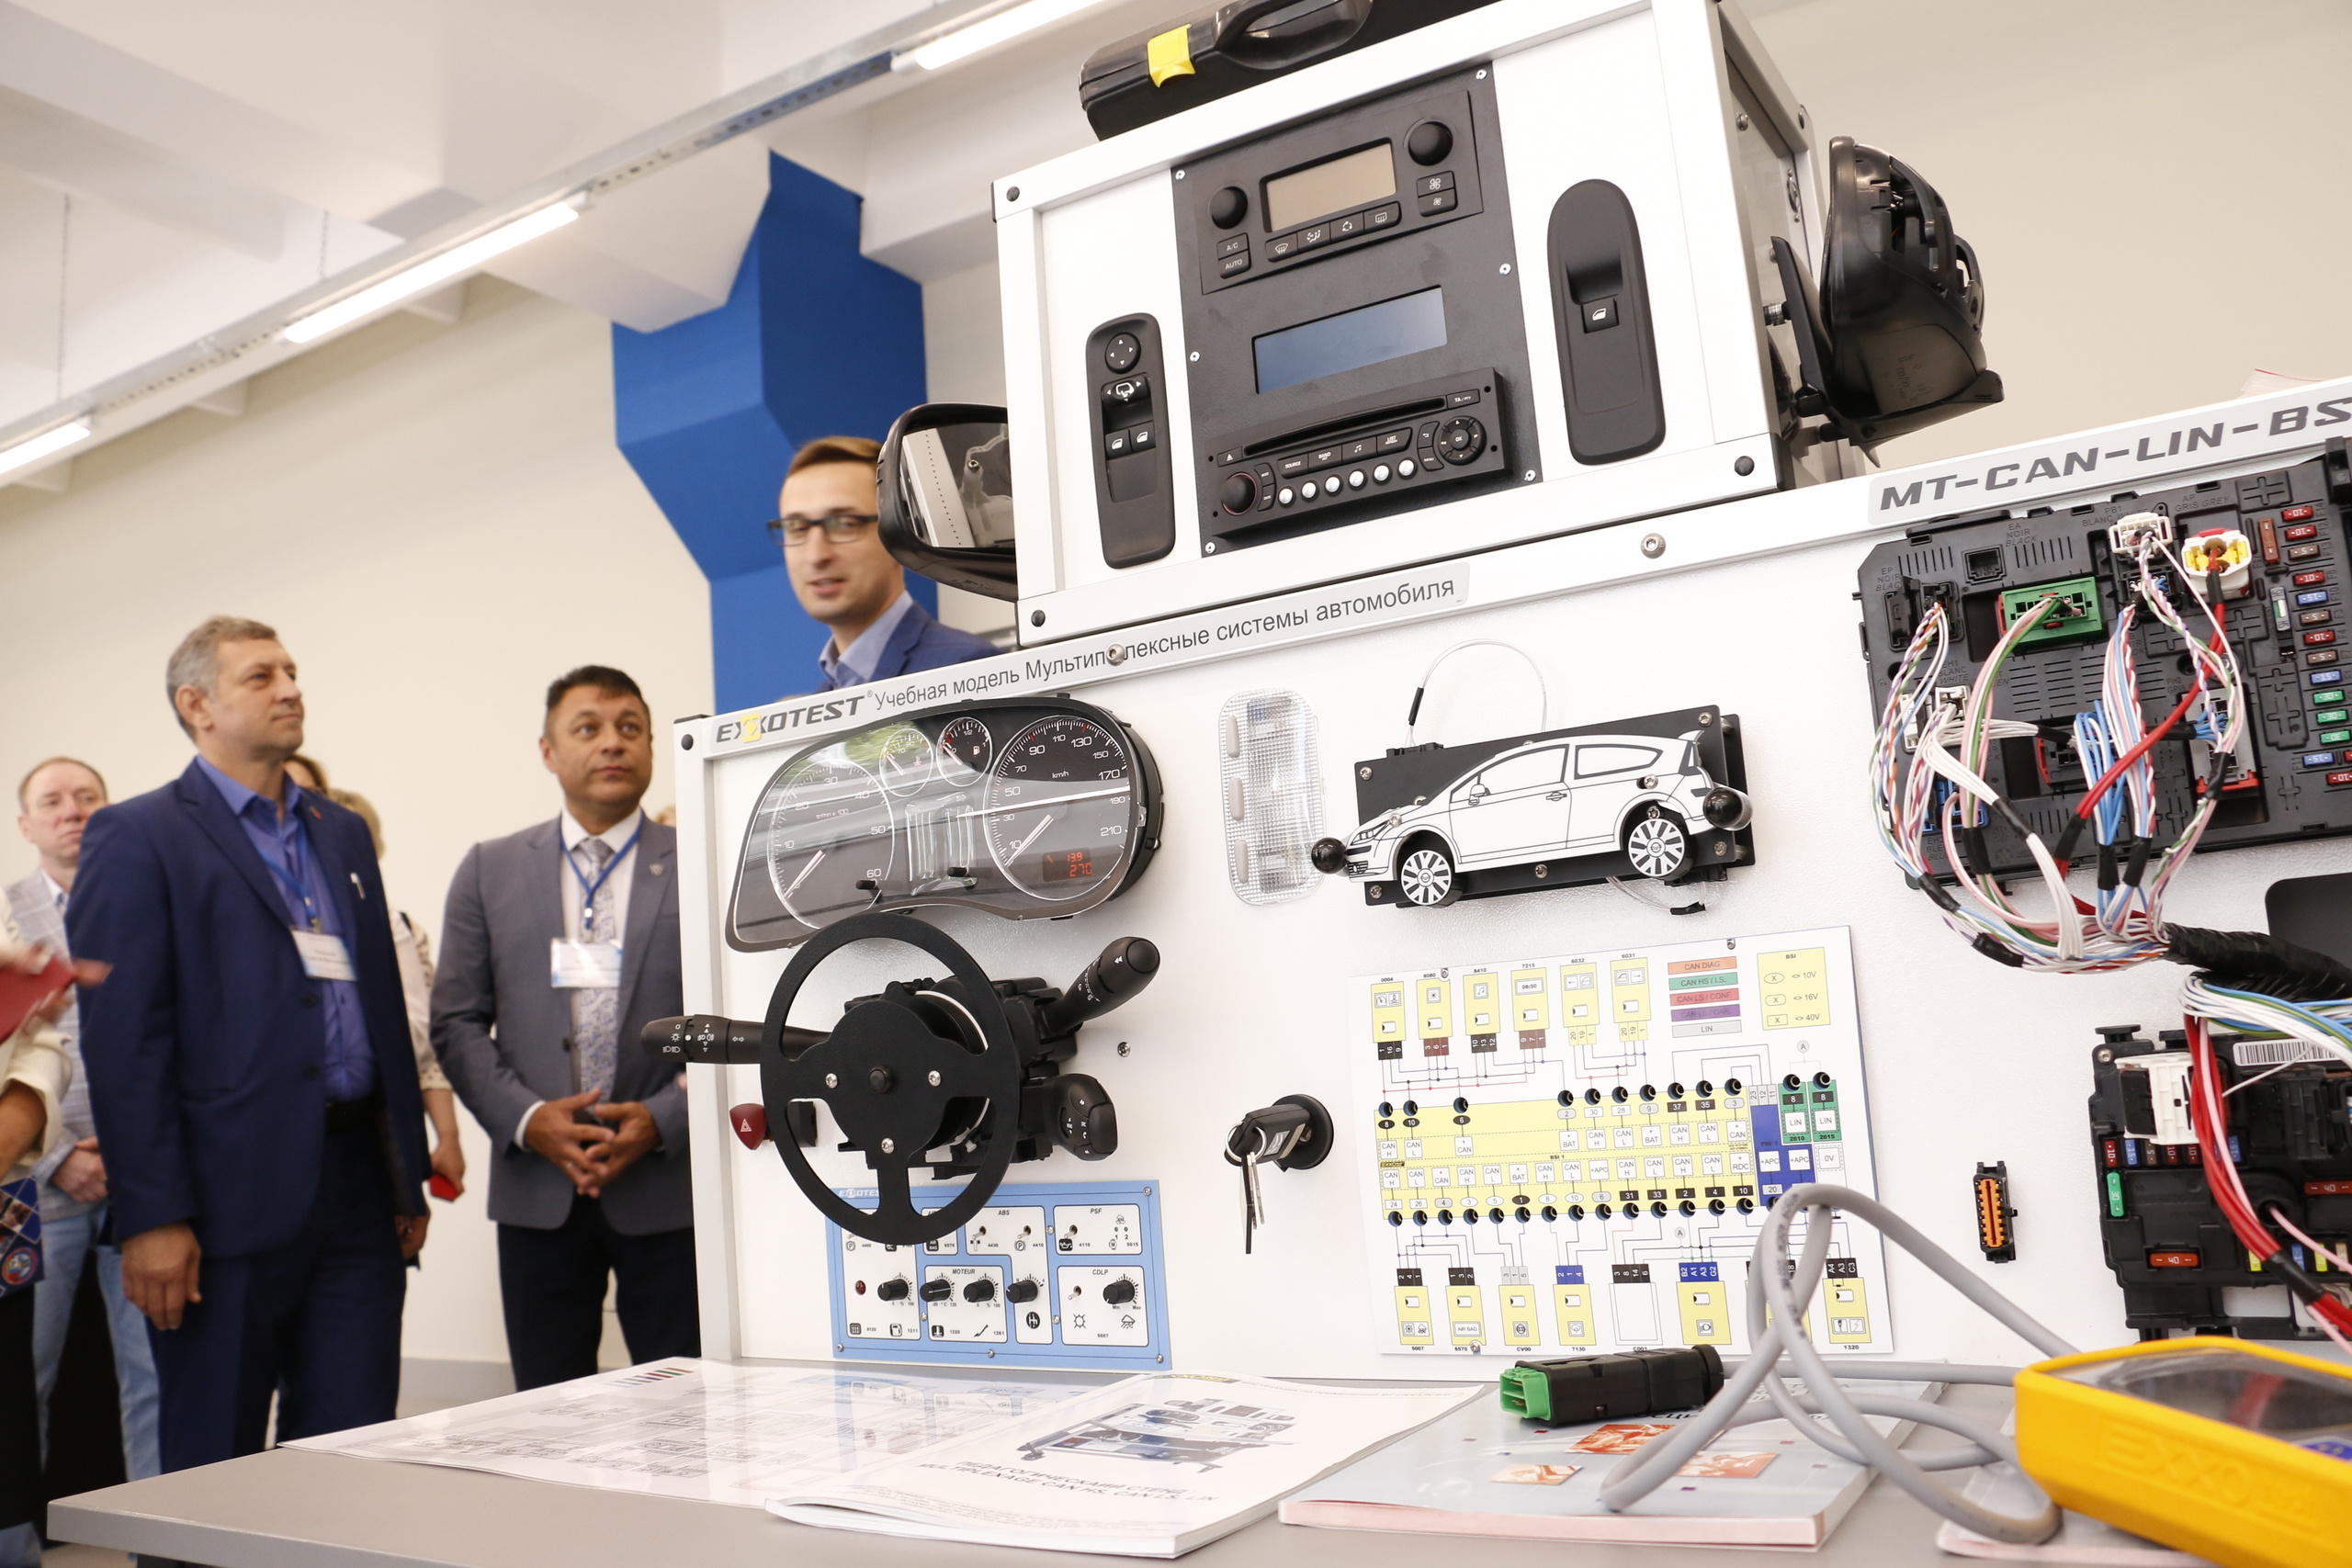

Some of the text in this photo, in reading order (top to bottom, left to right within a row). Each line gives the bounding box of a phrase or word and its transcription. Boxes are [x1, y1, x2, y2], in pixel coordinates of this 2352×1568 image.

[1227, 243, 1238, 252] A/C
[1226, 259, 1242, 270] AUTO
[1284, 461, 1302, 469] SOURCE
[2175, 496, 2230, 512] GRIS GREY
[2007, 528, 2030, 538] NOIR
[2006, 535, 2037, 547] BLACK
[2304, 574, 2314, 582] 10
[874, 580, 1455, 710] Учебная модель Мультиплексные системы автомобиля
[1939, 674, 1969, 684] WHITE
[717, 694, 865, 743] EXXOTEST
[1071, 737, 1091, 748] 130
[1029, 745, 1046, 755] 90
[1093, 750, 1109, 759] 150
[1015, 764, 1027, 773] 70
[1052, 770, 1069, 779] km/h
[1099, 769, 1120, 780] 170
[824, 776, 838, 786] 30
[855, 791, 870, 799] 40
[1005, 786, 1021, 796] 50
[796, 801, 809, 811] 20
[1003, 814, 1015, 822] 30
[871, 825, 886, 835] 50
[1101, 825, 1122, 837] 210
[784, 840, 795, 849] 10
[1009, 840, 1022, 850] 10
[867, 869, 882, 878] 60
[1684, 961, 1720, 971] CAN DIAG
[1680, 979, 1698, 987] CAN
[1678, 995, 1693, 1003] CAN
[1804, 993, 1819, 1001] 16V
[1750, 1090, 1757, 1100] 23
[1760, 1089, 1766, 1099] 12
[2108, 1149, 2116, 1158] 10
[2127, 1148, 2136, 1157] 15
[2324, 1184, 2336, 1192] 40
[1090, 1207, 1102, 1215] PSF
[2168, 1256, 2180, 1264] 40
[1681, 1267, 1689, 1277] B2
[1690, 1267, 1698, 1277] A1
[1701, 1267, 1708, 1276] A3
[1710, 1266, 1717, 1277] G2
[1827, 1263, 1836, 1273] A4
[1838, 1263, 1846, 1273] A3
[1849, 1262, 1856, 1273] C3
[1633, 1269, 1639, 1278] 14
[916, 1463, 1040, 1484] MULTIPLEXAGE
[1041, 1482, 1081, 1491] CAN
